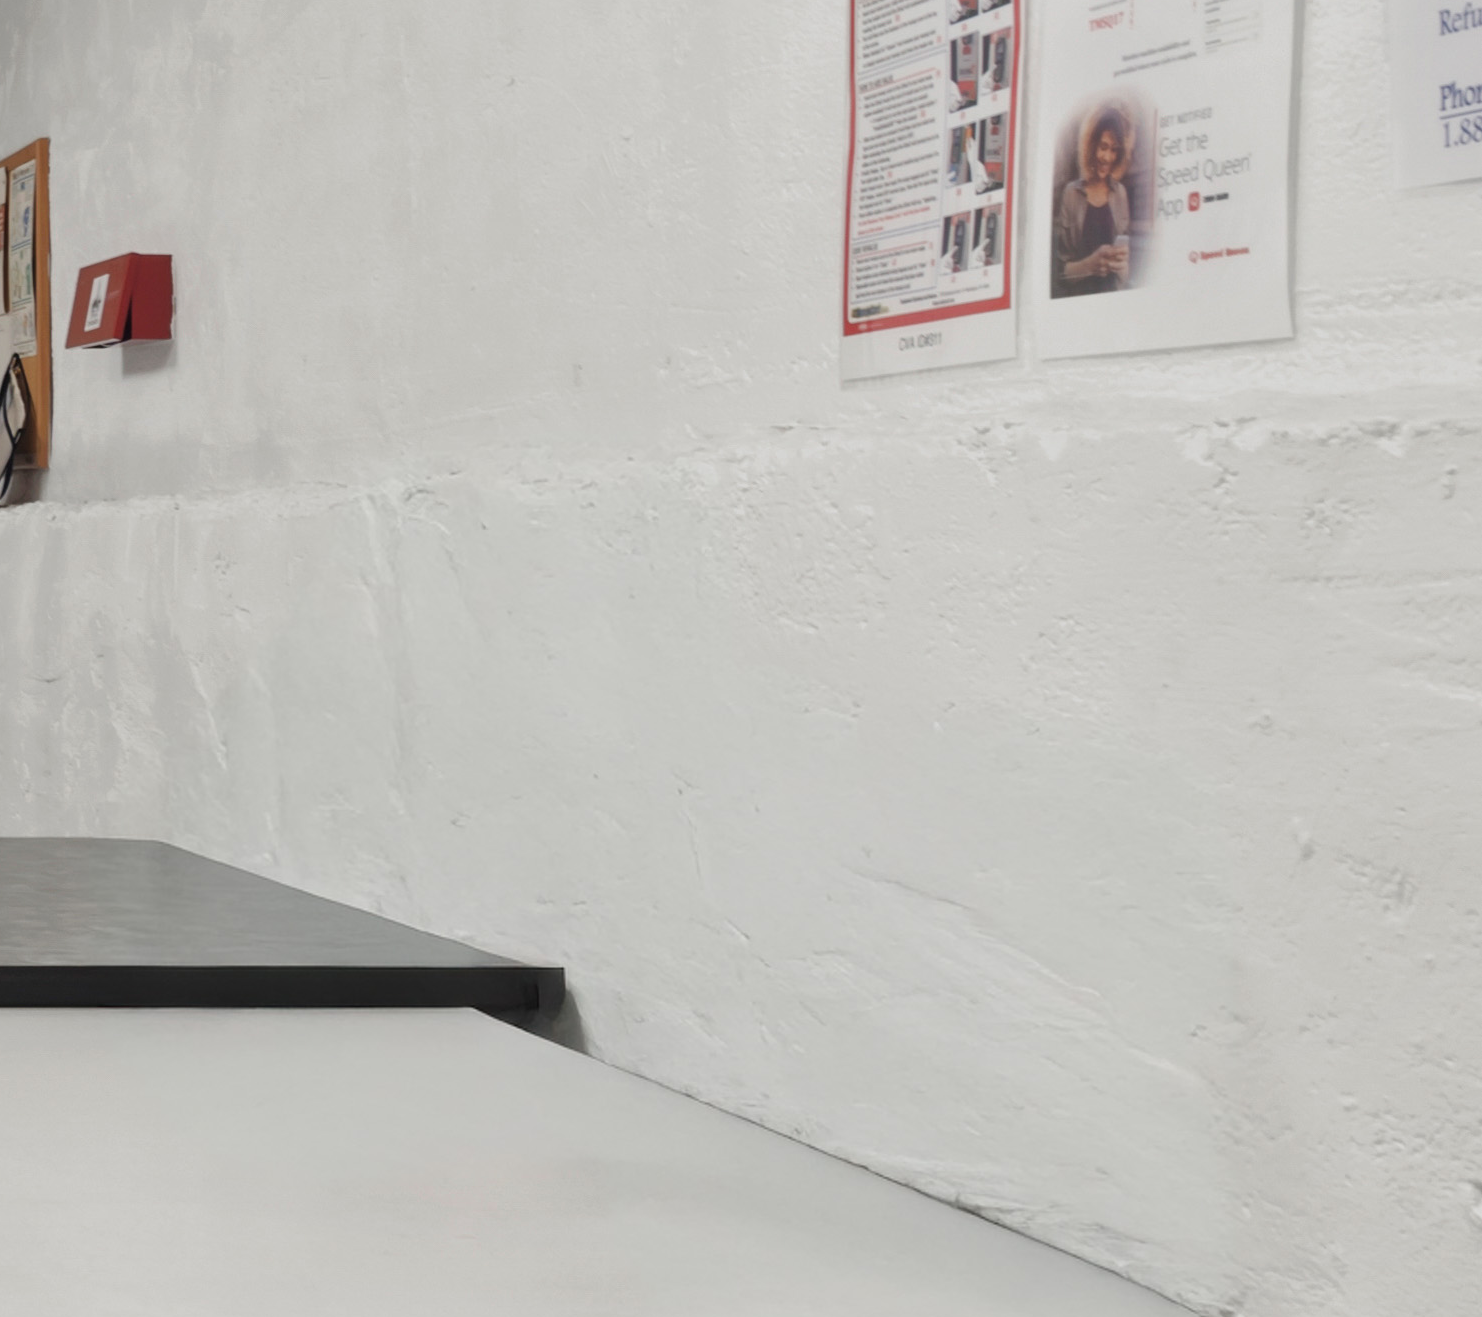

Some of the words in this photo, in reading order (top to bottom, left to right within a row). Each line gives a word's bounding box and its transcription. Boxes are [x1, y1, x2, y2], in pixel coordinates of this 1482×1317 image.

[1159, 136, 1183, 158] Get
[1186, 134, 1209, 153] the
[1157, 161, 1199, 189] Speed
[1158, 198, 1184, 220] App
